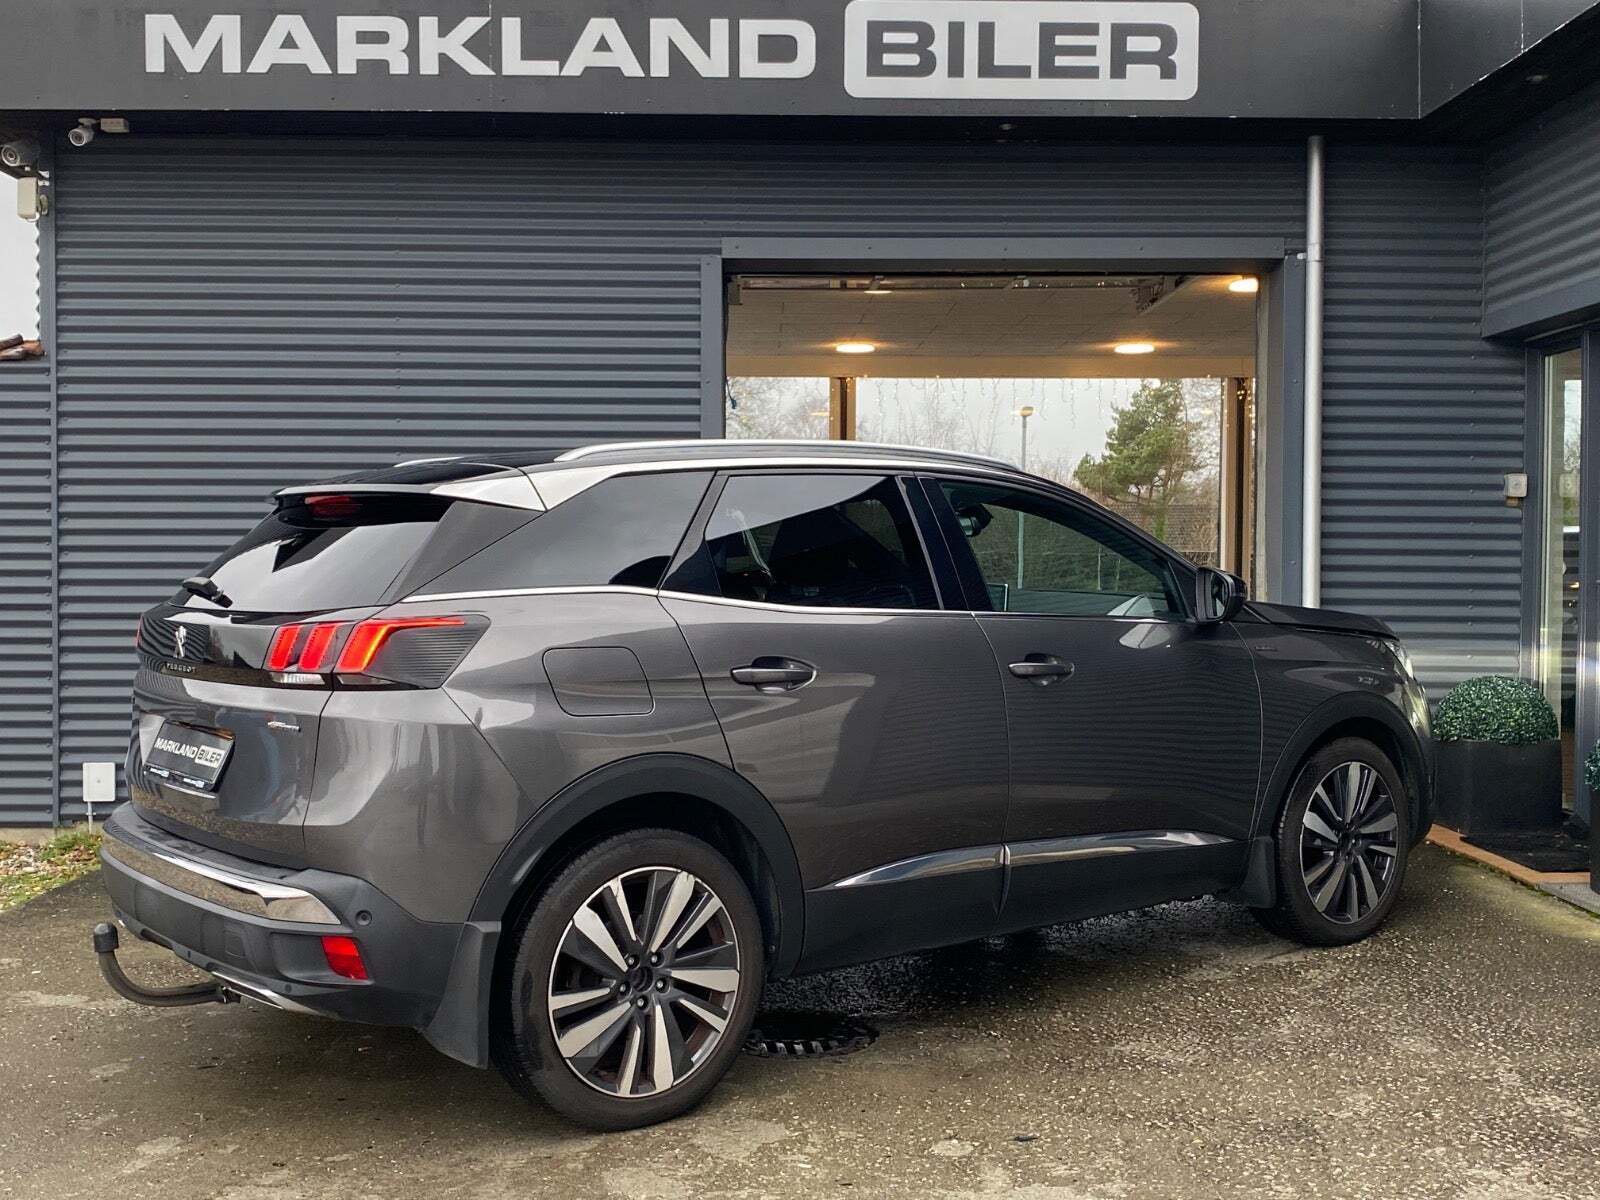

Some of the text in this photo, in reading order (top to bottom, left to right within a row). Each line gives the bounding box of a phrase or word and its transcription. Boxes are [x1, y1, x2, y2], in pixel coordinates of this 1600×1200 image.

[144, 14, 1180, 80] MARKLAND BILER
[154, 737, 222, 763] MARKLAND BILER
